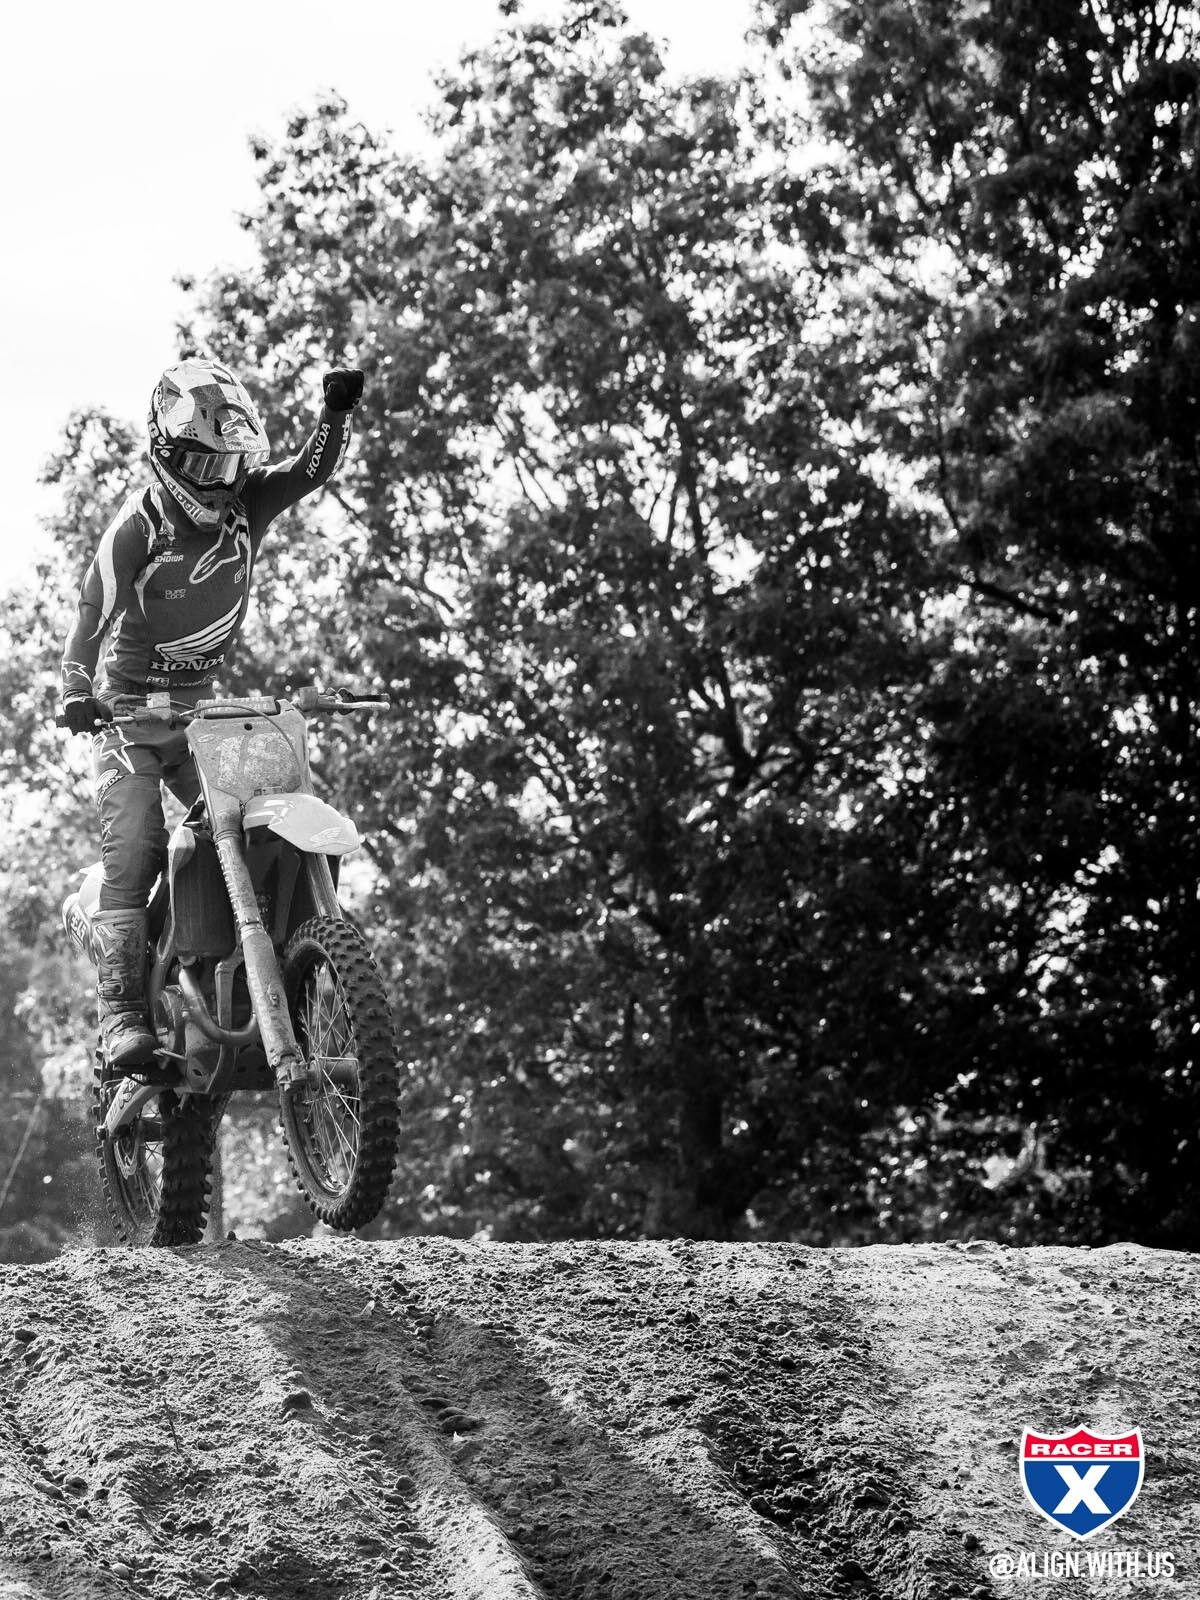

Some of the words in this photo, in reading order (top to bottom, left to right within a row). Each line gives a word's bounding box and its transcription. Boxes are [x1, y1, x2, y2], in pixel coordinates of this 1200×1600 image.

[305, 422, 331, 479] HONDA
[154, 554, 184, 563] SHOWA
[150, 654, 225, 672] HONDA
